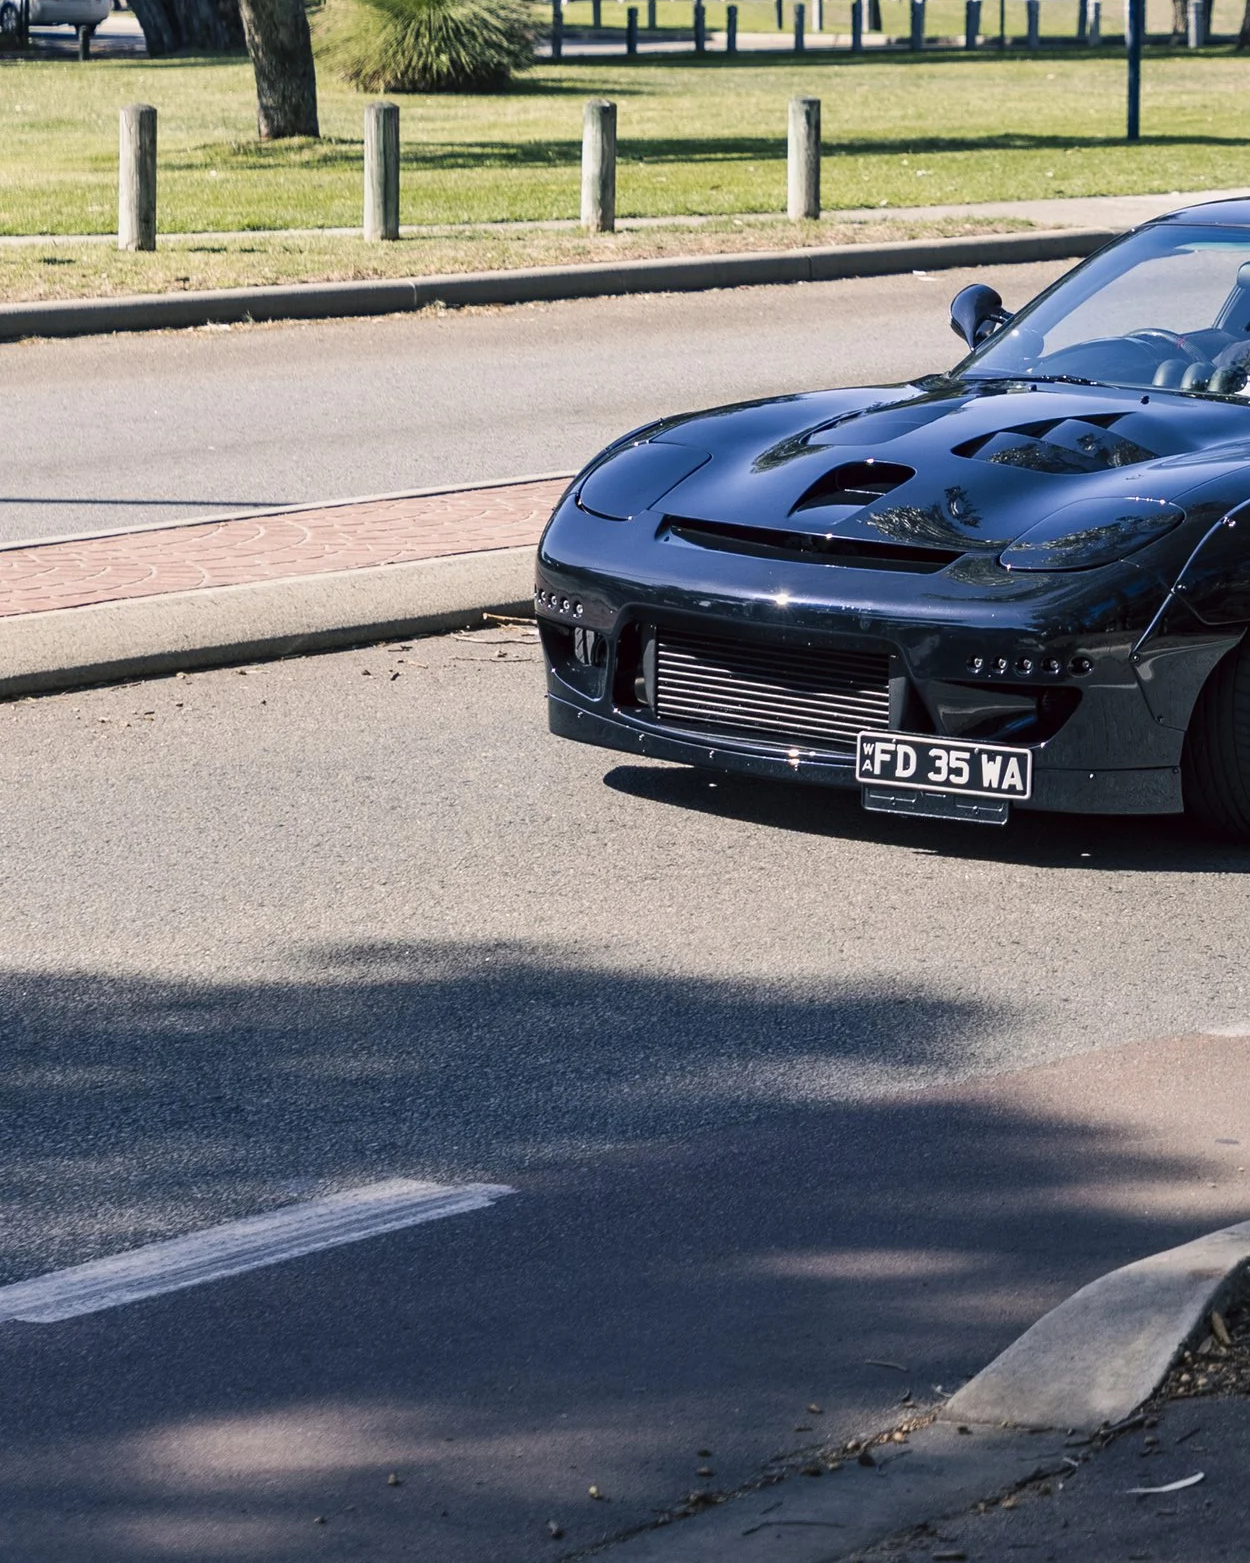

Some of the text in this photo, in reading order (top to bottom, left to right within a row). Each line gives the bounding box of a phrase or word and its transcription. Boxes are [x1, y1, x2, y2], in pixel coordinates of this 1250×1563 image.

[873, 742, 1024, 791] FD 35 WA
